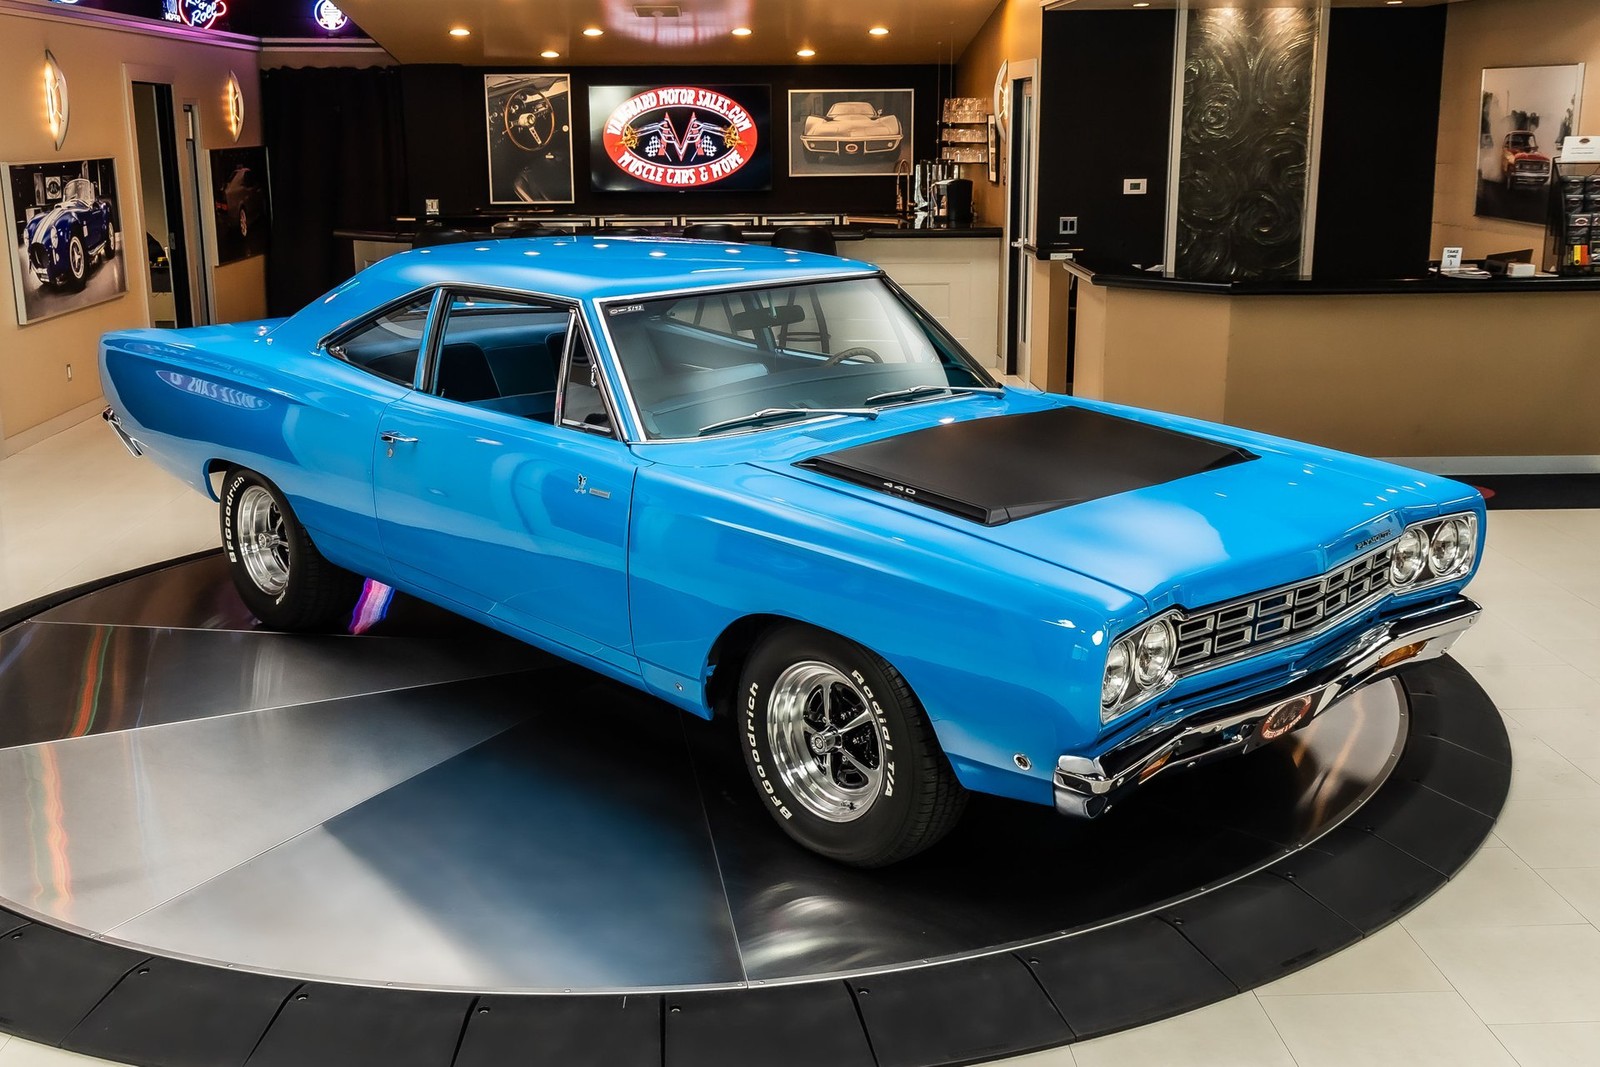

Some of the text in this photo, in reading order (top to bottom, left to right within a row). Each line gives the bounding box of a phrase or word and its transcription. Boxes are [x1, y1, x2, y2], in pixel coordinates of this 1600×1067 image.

[606, 88, 753, 135] VANGUARD MOTOR SALES.COM
[617, 150, 745, 185] MUSCLE CARS & MORE
[225, 476, 245, 563] BFGoodrich
[883, 482, 916, 495] 440
[745, 682, 793, 820] BFGoodrich
[851, 669, 895, 797] Radial T/A
